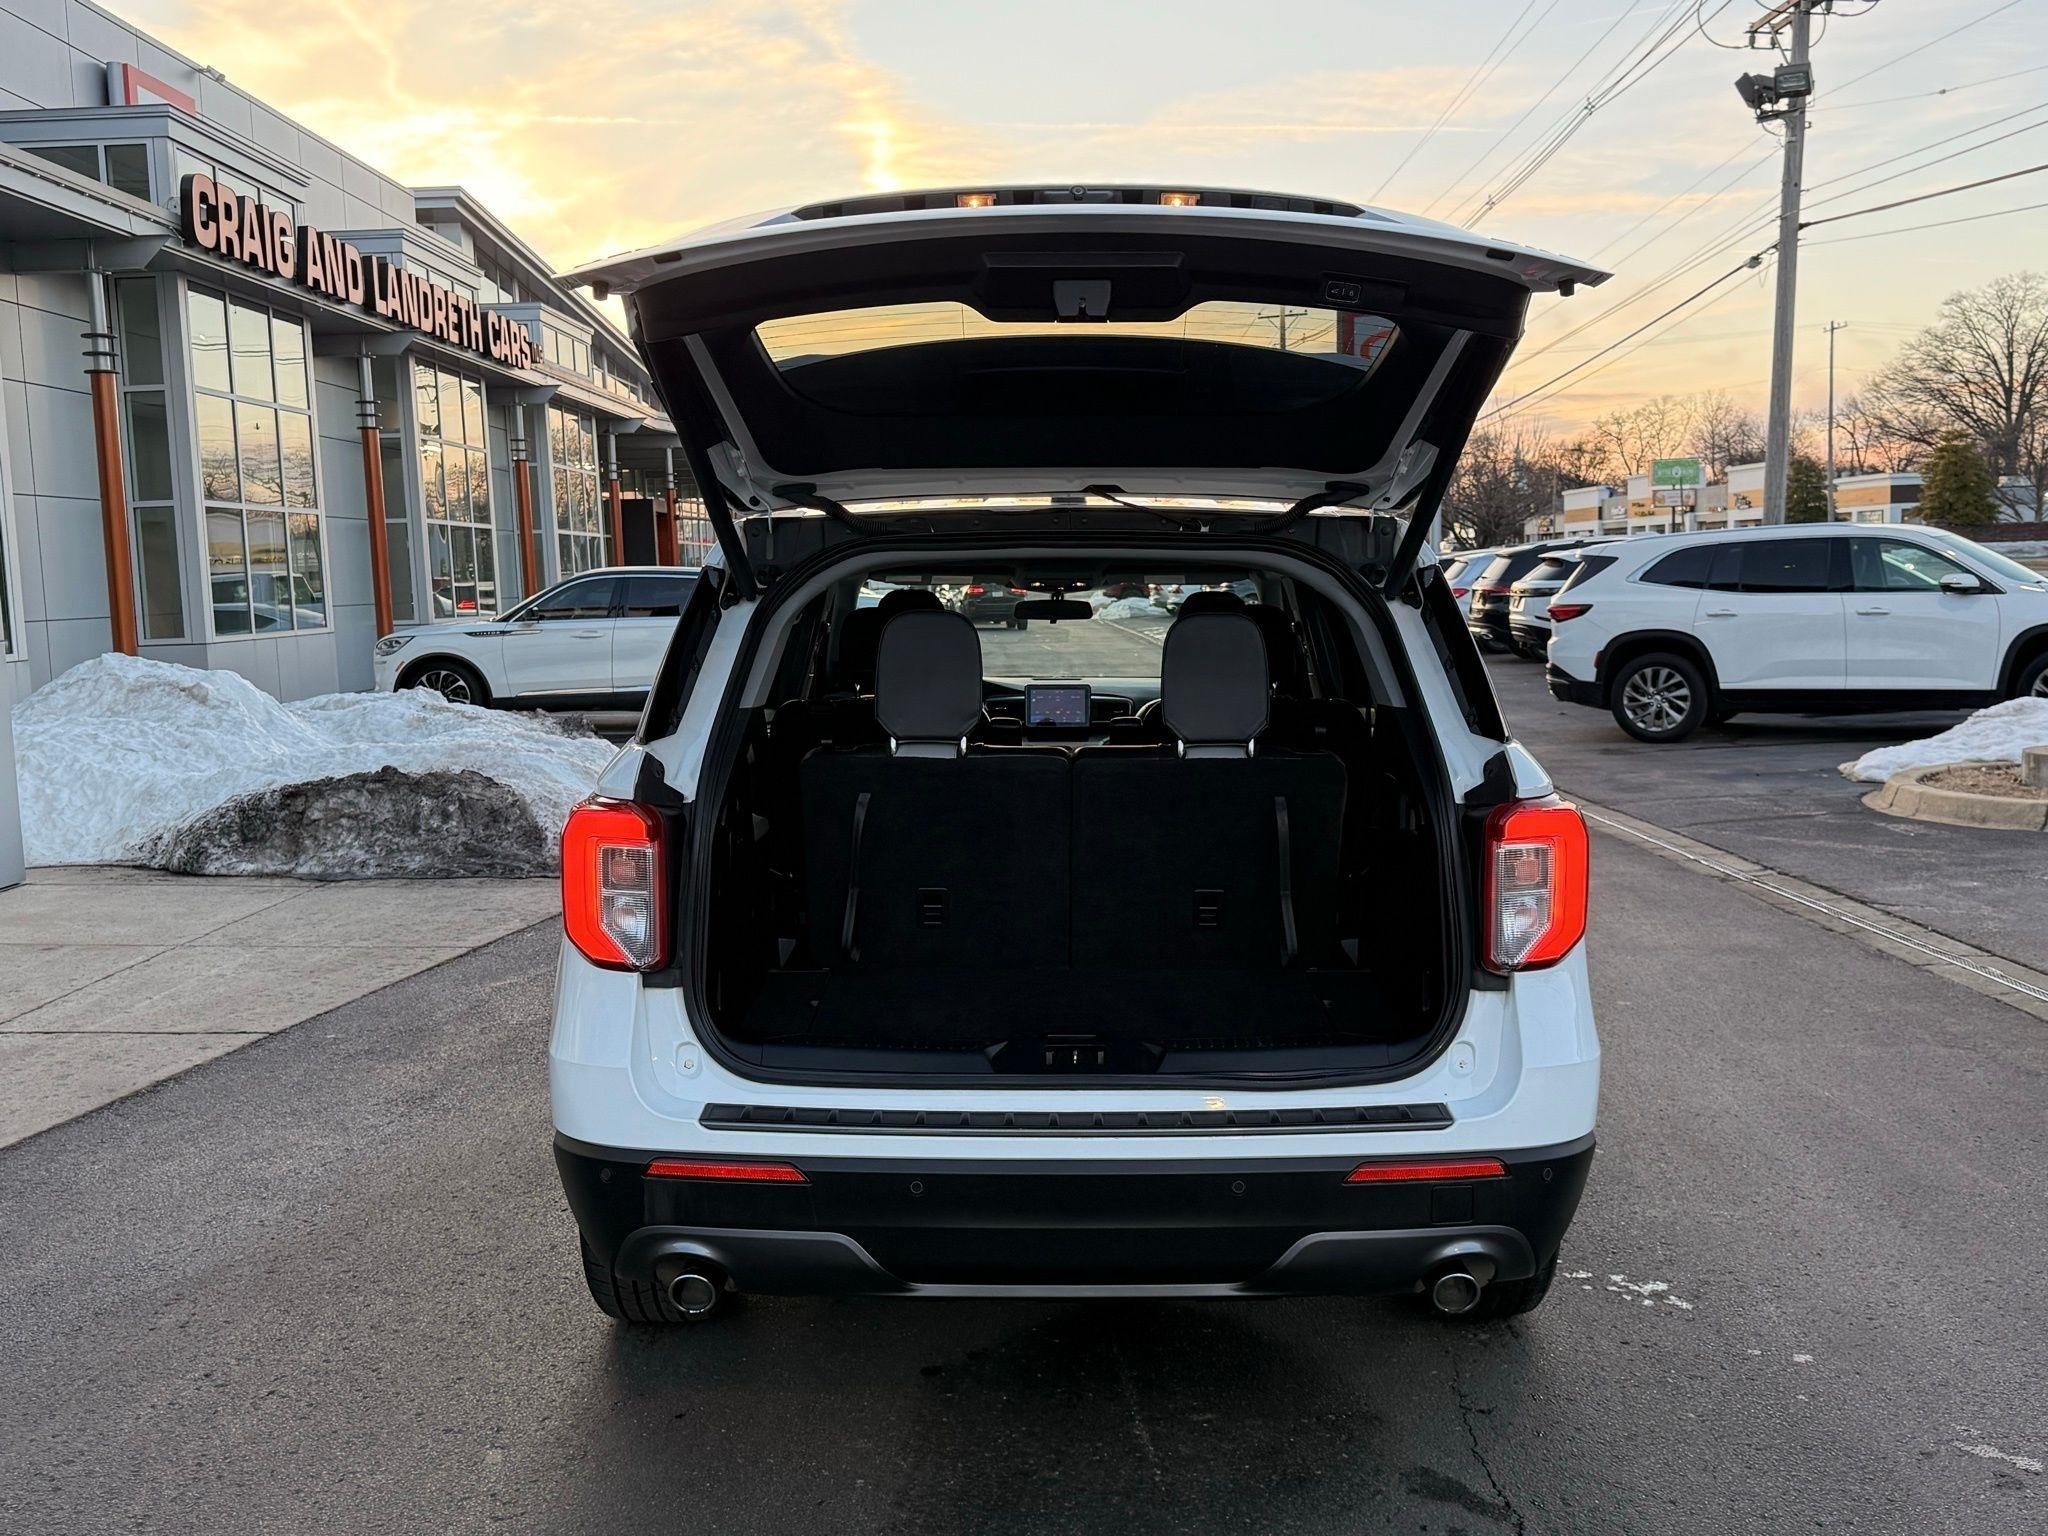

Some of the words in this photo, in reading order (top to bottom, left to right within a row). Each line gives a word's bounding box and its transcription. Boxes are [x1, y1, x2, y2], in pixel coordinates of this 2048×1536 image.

[191, 172, 295, 279] CRAIG
[306, 225, 364, 306] AND
[371, 255, 484, 354] LANDRETH
[487, 308, 532, 371] CARS
